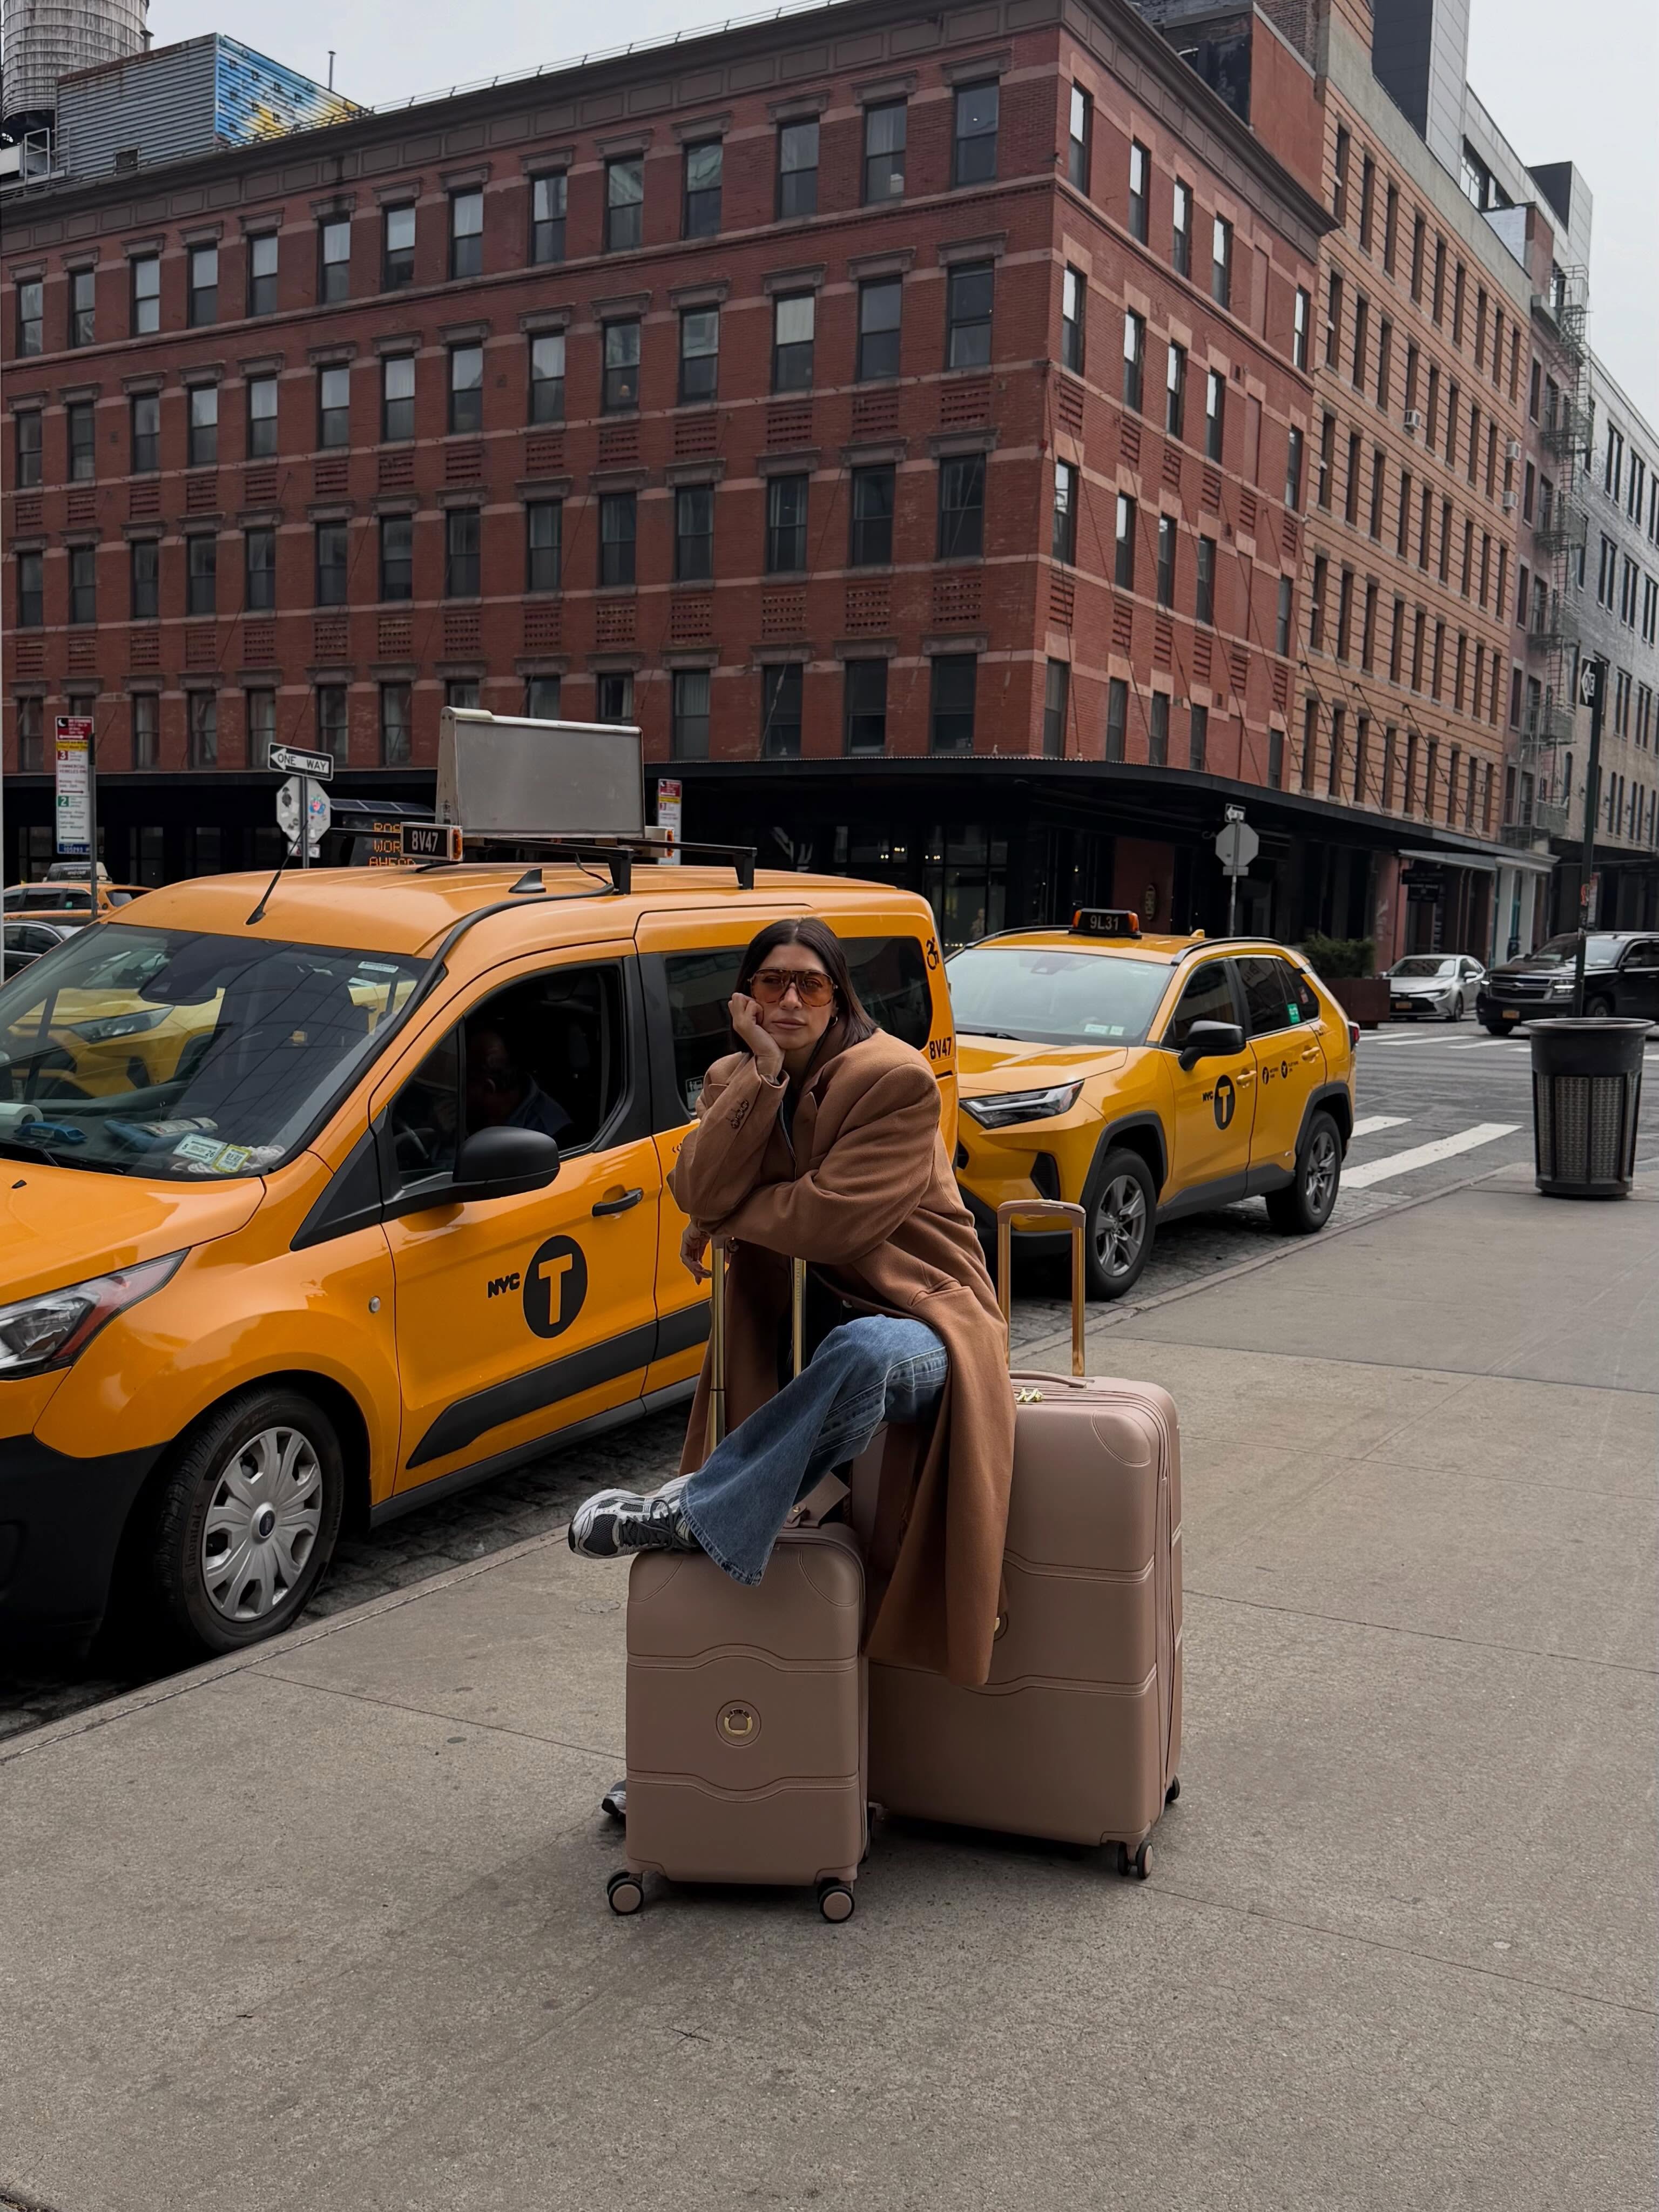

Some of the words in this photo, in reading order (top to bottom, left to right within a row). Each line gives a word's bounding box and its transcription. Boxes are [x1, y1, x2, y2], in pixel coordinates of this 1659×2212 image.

[60, 750, 66, 759] 3
[277, 753, 296, 766] ONE
[306, 759, 327, 771] WAY
[60, 797, 66, 806] 2
[411, 830, 439, 853] 8V47
[1090, 914, 1119, 931] 9L31
[929, 1036, 952, 1060] 8V47
[1202, 1090, 1213, 1102] NYC
[487, 1272, 521, 1298] NYC
